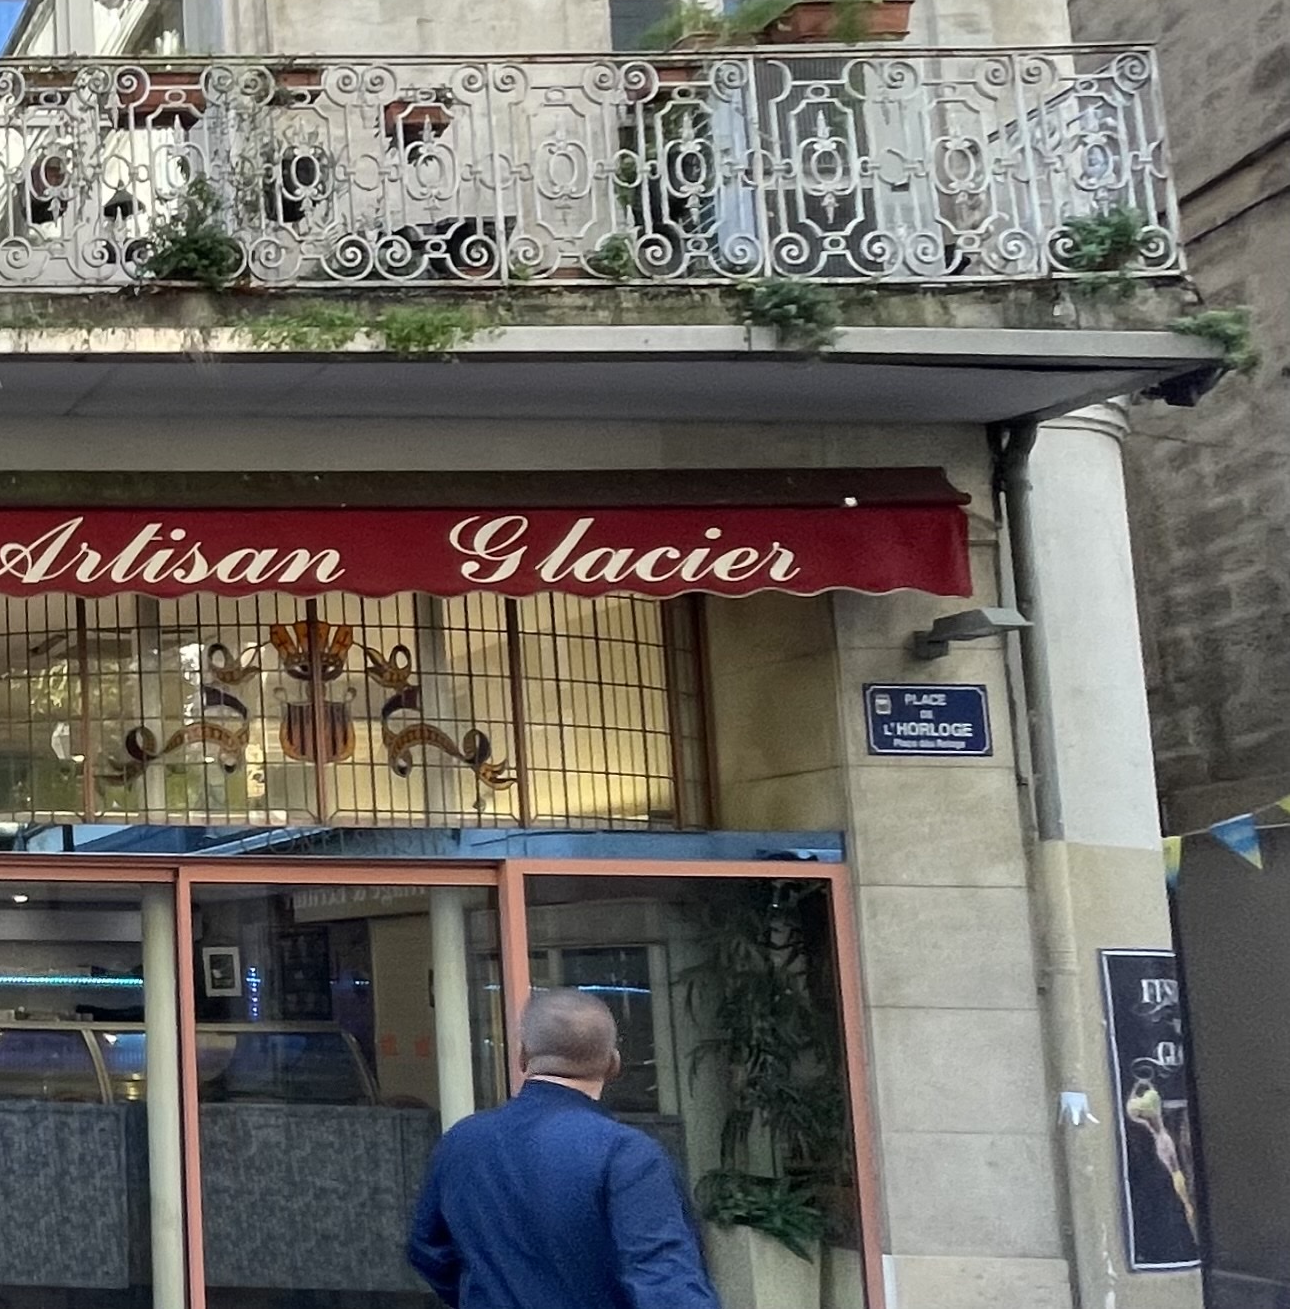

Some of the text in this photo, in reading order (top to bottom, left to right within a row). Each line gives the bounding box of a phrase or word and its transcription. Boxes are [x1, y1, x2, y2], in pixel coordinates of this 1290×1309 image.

[449, 515, 801, 584] Glacier
[904, 694, 947, 706] PLACE
[883, 722, 973, 737] L'HORLOGE
